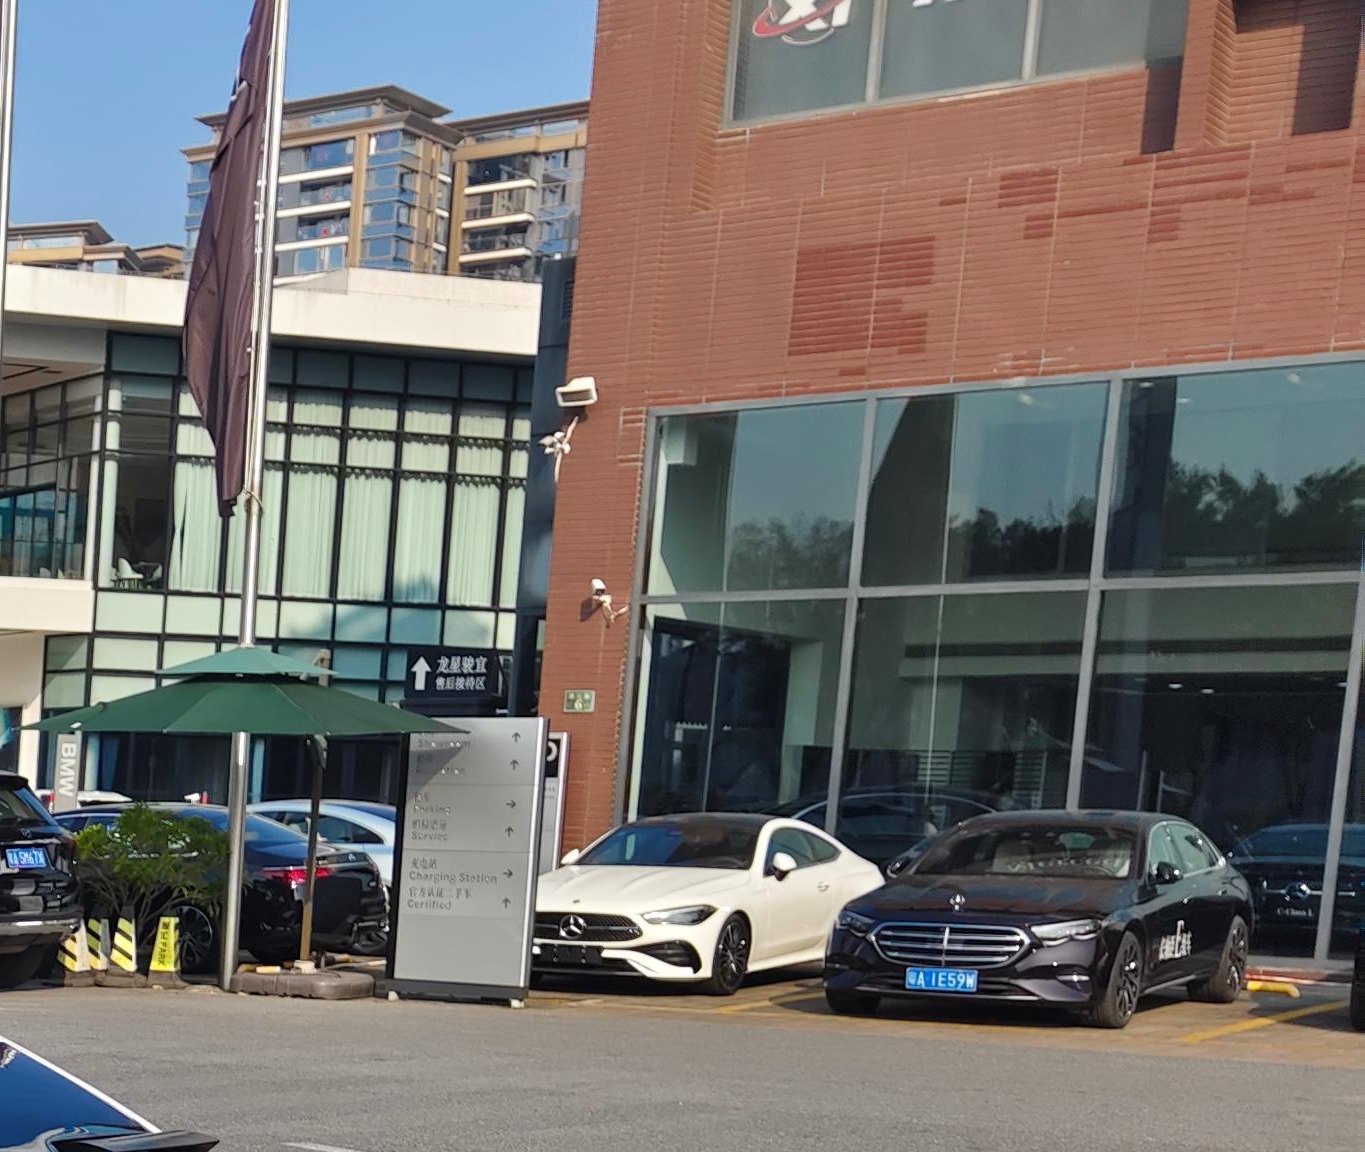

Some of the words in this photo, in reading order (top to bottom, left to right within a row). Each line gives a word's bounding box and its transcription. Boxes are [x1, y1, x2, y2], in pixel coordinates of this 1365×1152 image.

[58, 742, 77, 797] BMW
[409, 870, 456, 884] Charging
[459, 872, 498, 883] Station
[407, 899, 452, 910] Certified
